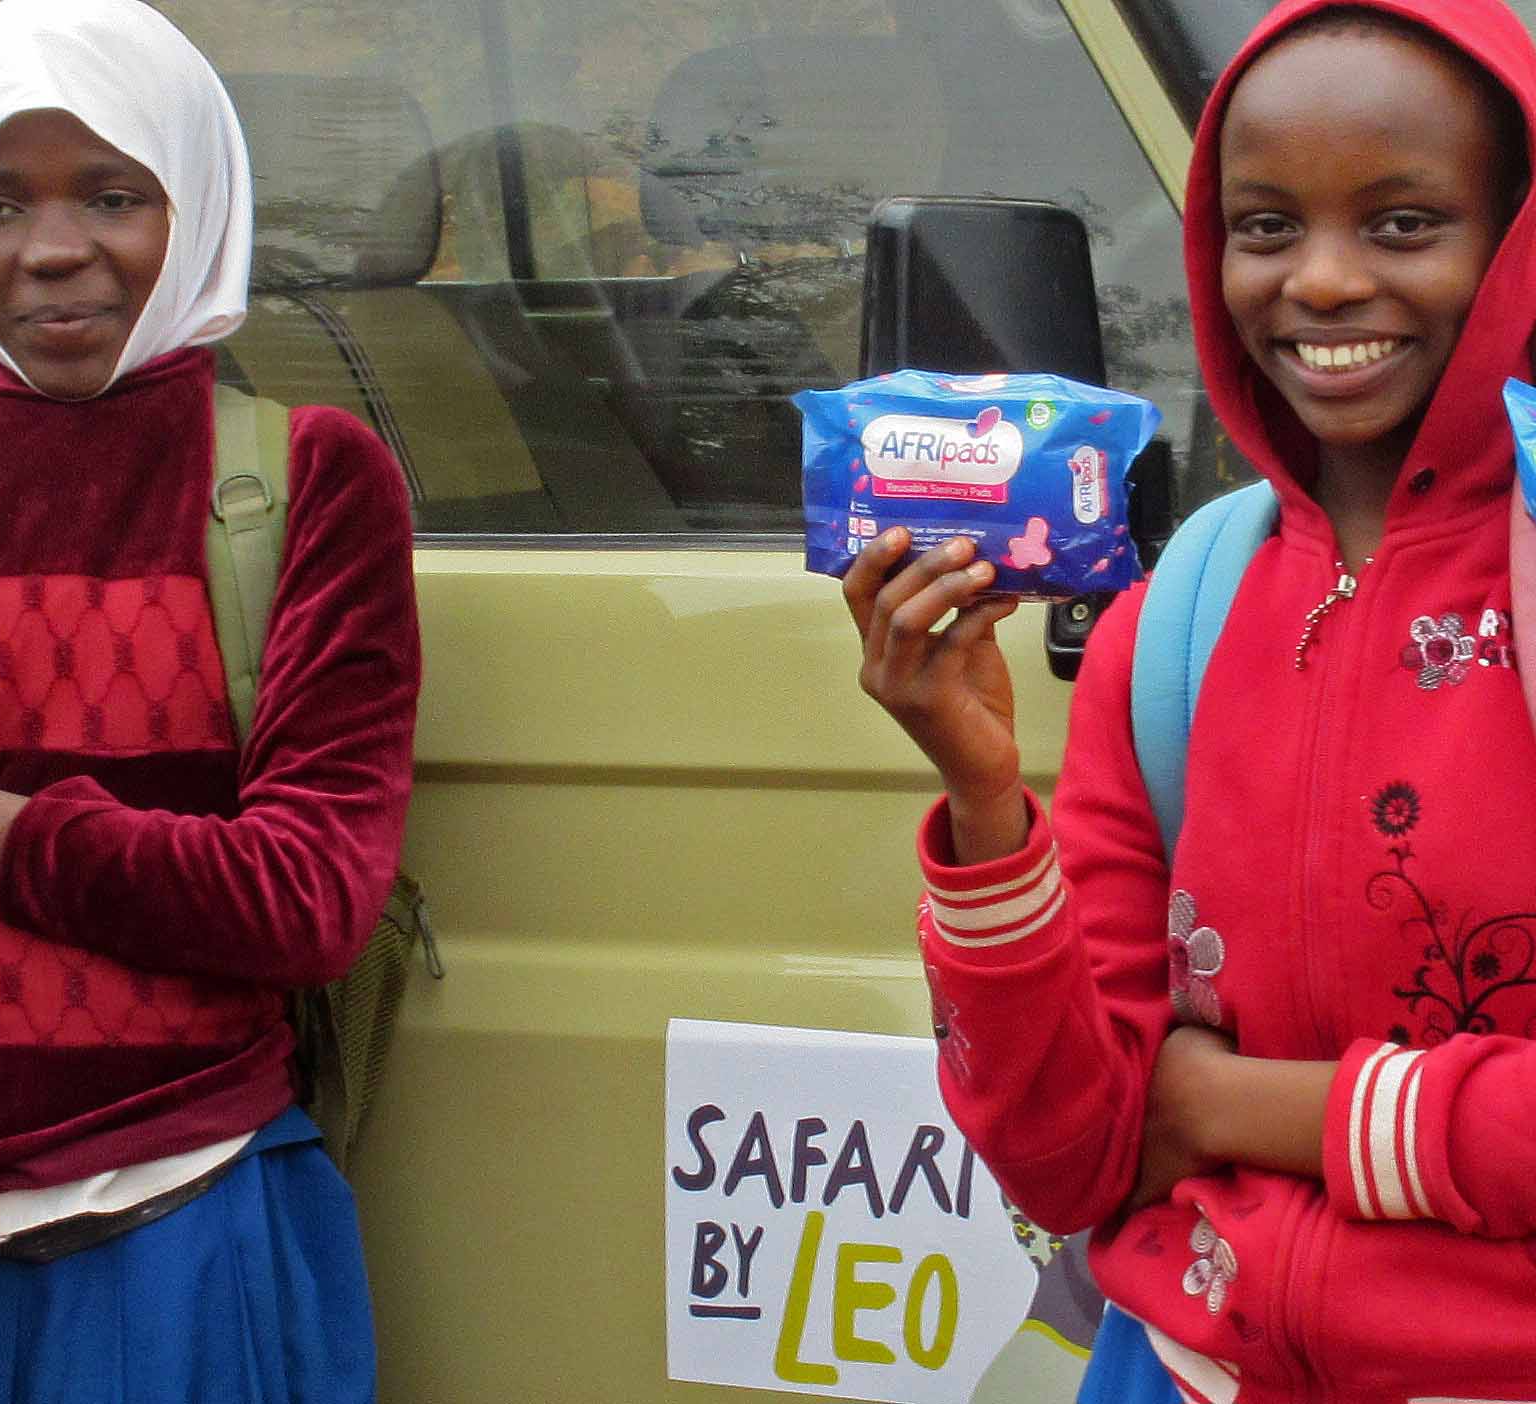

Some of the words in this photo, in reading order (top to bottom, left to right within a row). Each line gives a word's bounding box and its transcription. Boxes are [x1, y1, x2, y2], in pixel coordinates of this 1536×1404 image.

[879, 431, 999, 470] AFRIpads
[969, 486, 992, 498] Pads
[672, 1104, 974, 1219] SAFARI
[690, 1220, 764, 1299] BY
[773, 1210, 960, 1386] LEO
